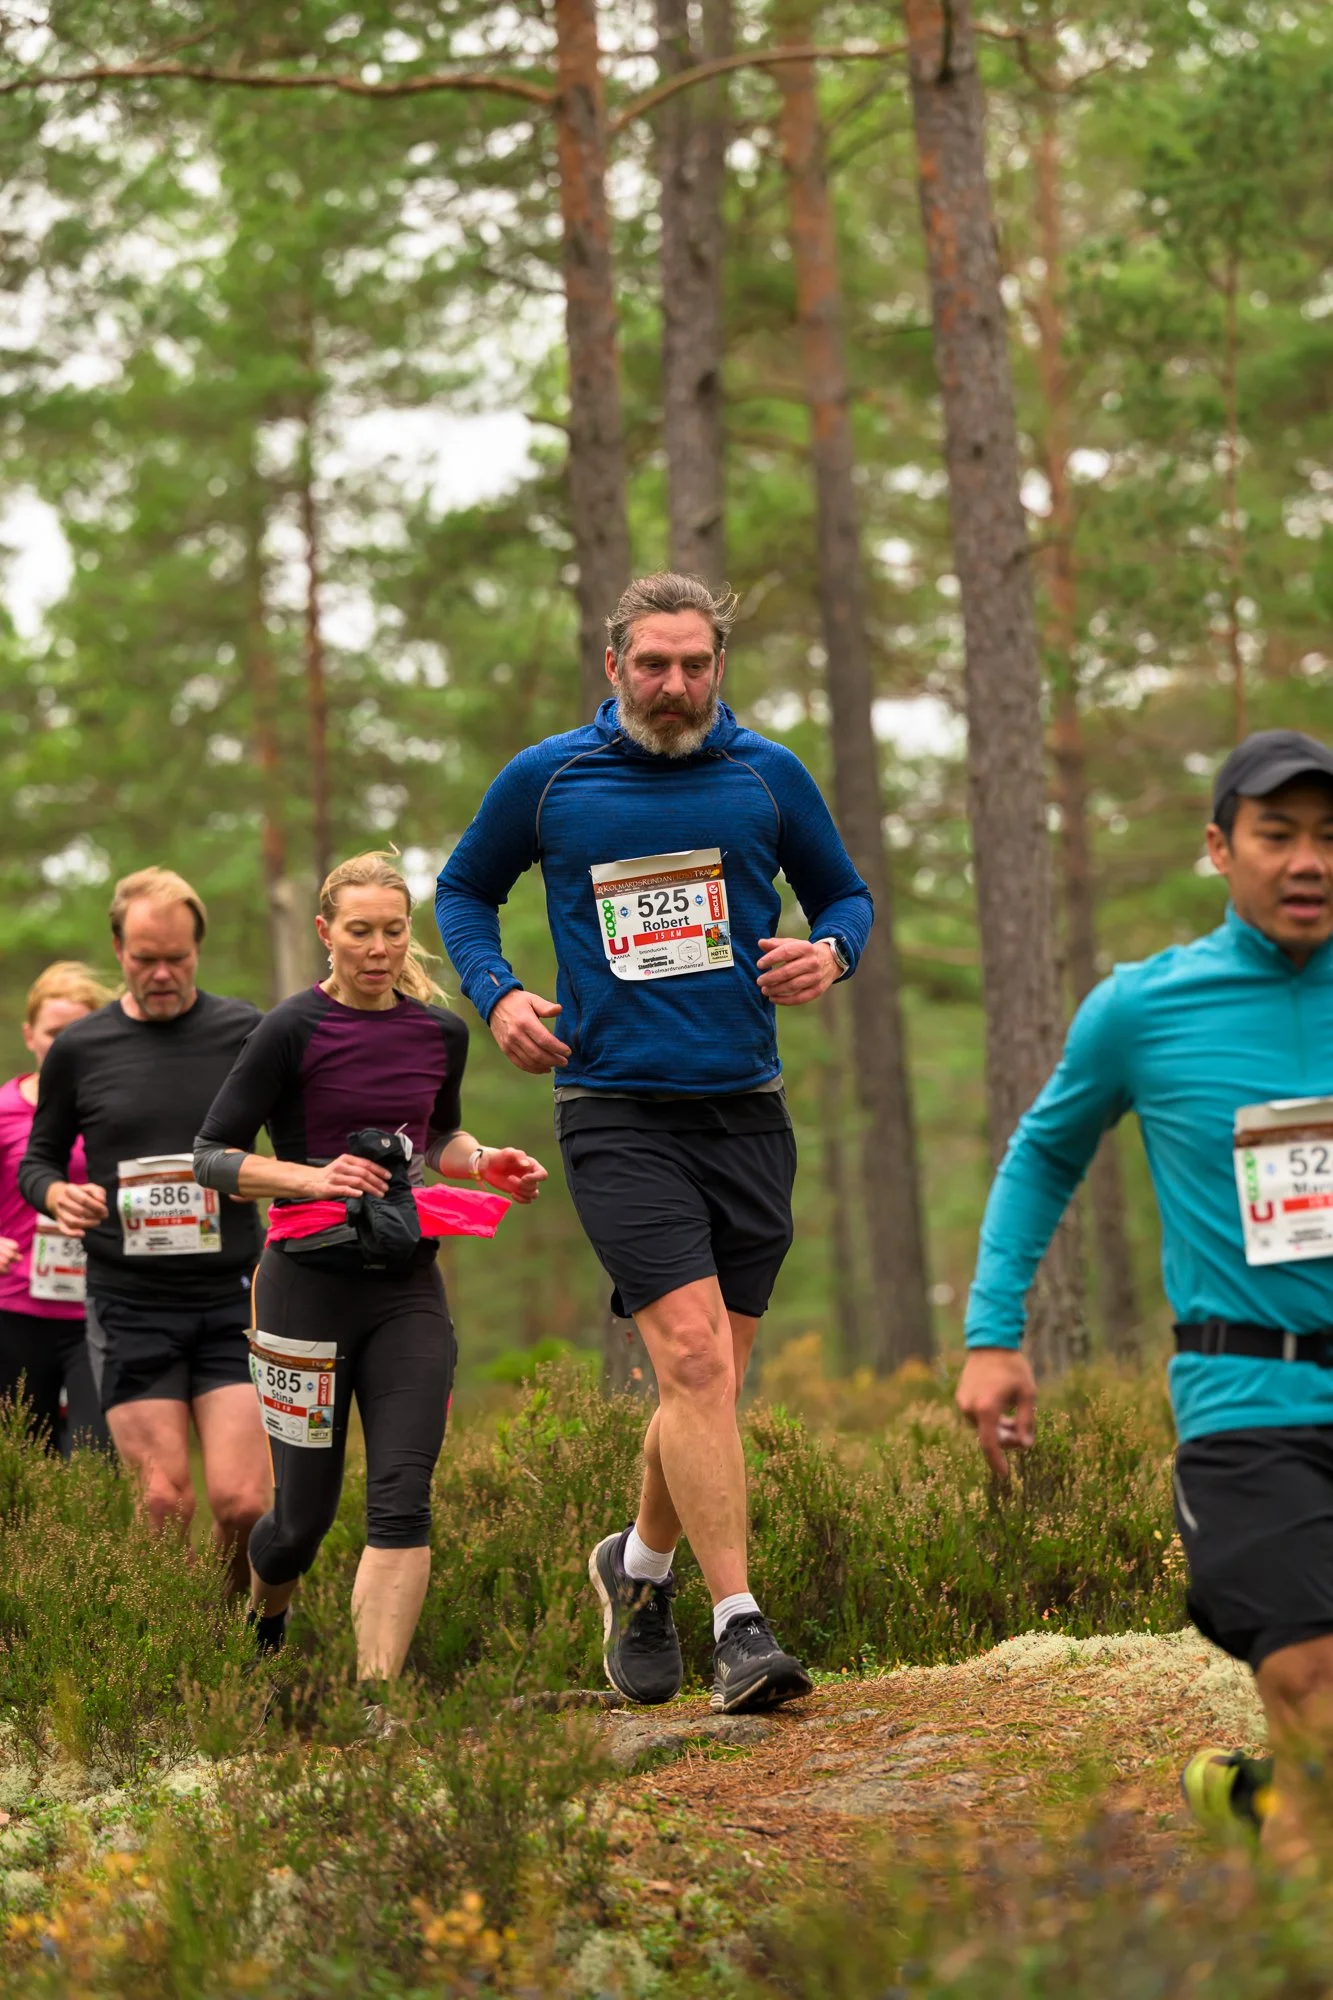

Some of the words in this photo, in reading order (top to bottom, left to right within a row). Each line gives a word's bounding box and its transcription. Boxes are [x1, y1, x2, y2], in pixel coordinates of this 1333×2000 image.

[638, 888, 690, 918] 525
[712, 895, 720, 917] CIRCLE
[602, 899, 616, 938] coop
[643, 916, 690, 932] Robert
[655, 932, 665, 941] 15
[149, 1185, 190, 1206] 586
[267, 1366, 301, 1393] 585
[272, 1389, 294, 1404] Stina
